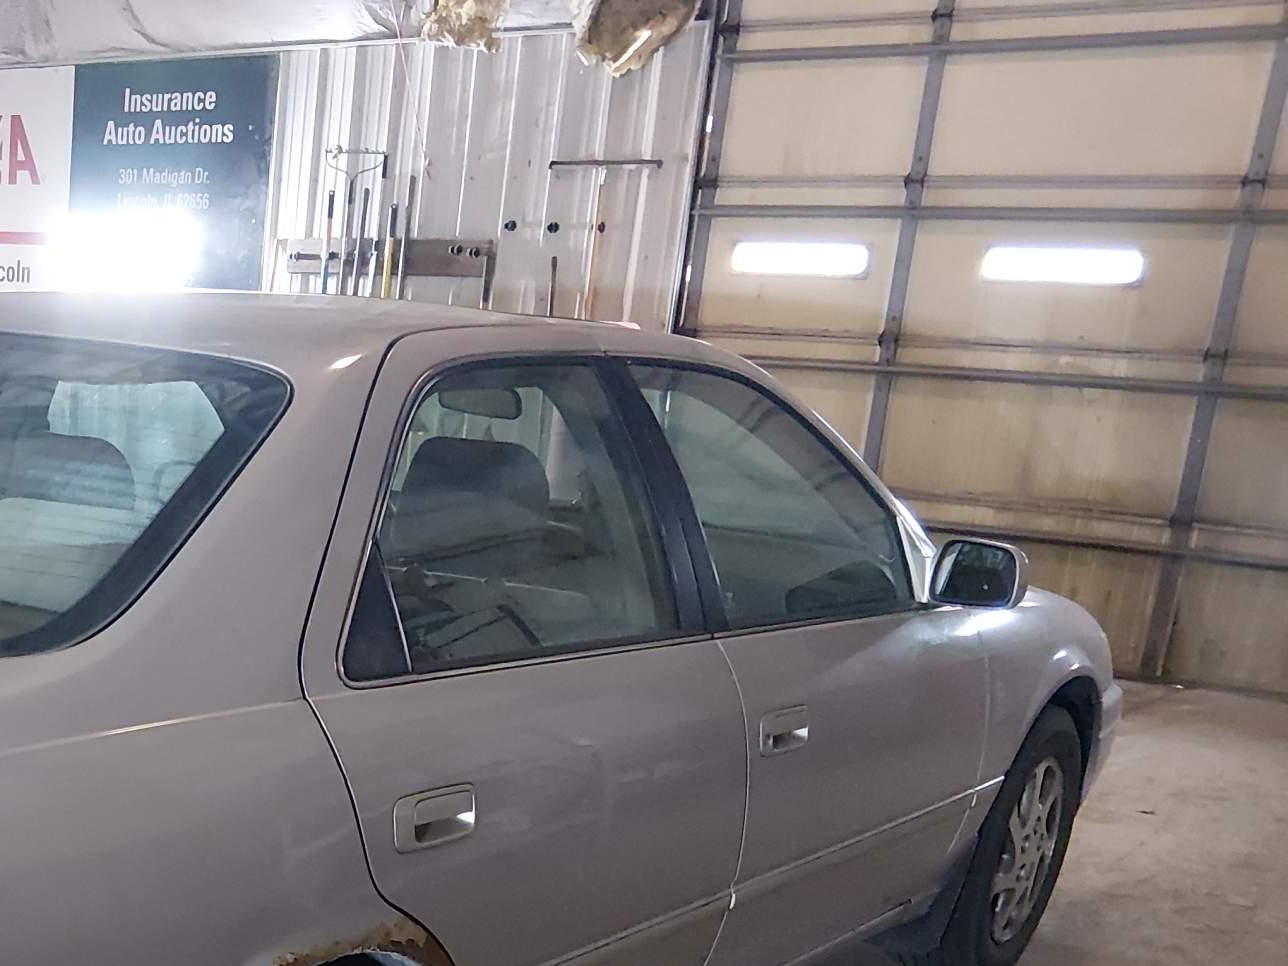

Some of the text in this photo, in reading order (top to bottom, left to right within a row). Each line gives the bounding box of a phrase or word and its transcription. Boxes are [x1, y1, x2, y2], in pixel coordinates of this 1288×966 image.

[123, 87, 217, 113] Insurance
[103, 117, 234, 145] Auto Auctions
[118, 167, 210, 188] 301 Madigan Dr.
